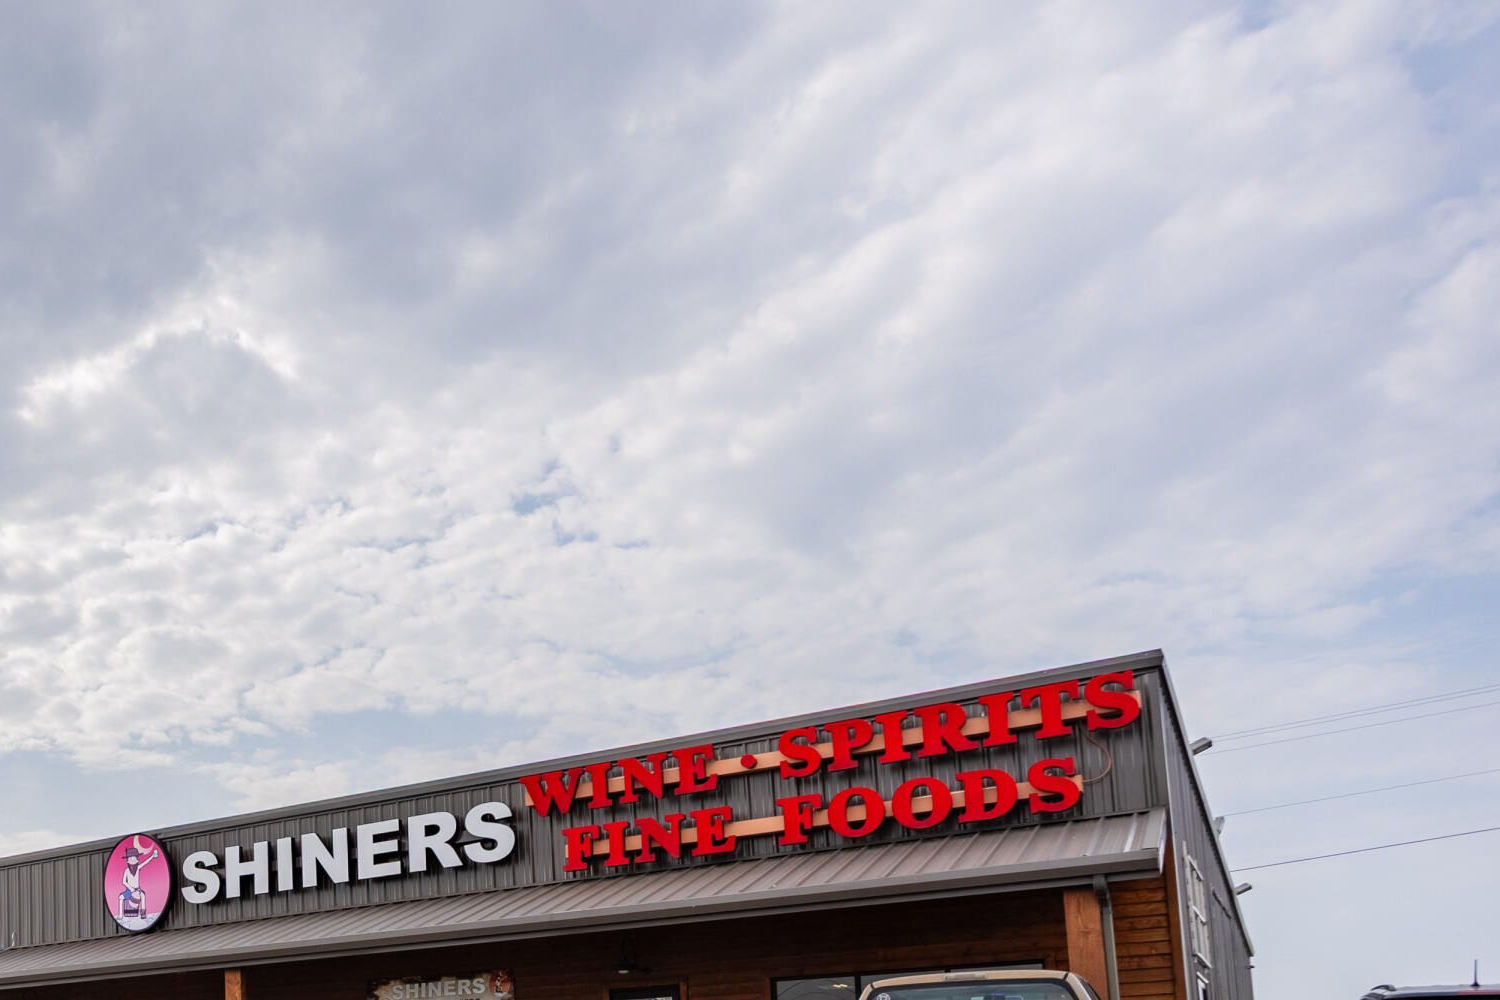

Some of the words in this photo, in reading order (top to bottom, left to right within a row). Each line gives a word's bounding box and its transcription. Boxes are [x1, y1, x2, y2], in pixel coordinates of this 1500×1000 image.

[519, 743, 718, 817] WINE
[777, 669, 1142, 780] SPIRITS
[181, 801, 516, 904] SHINERS
[561, 804, 737, 872] FINE
[776, 756, 1085, 846] FOODS
[392, 977, 486, 1000] SHINERS
